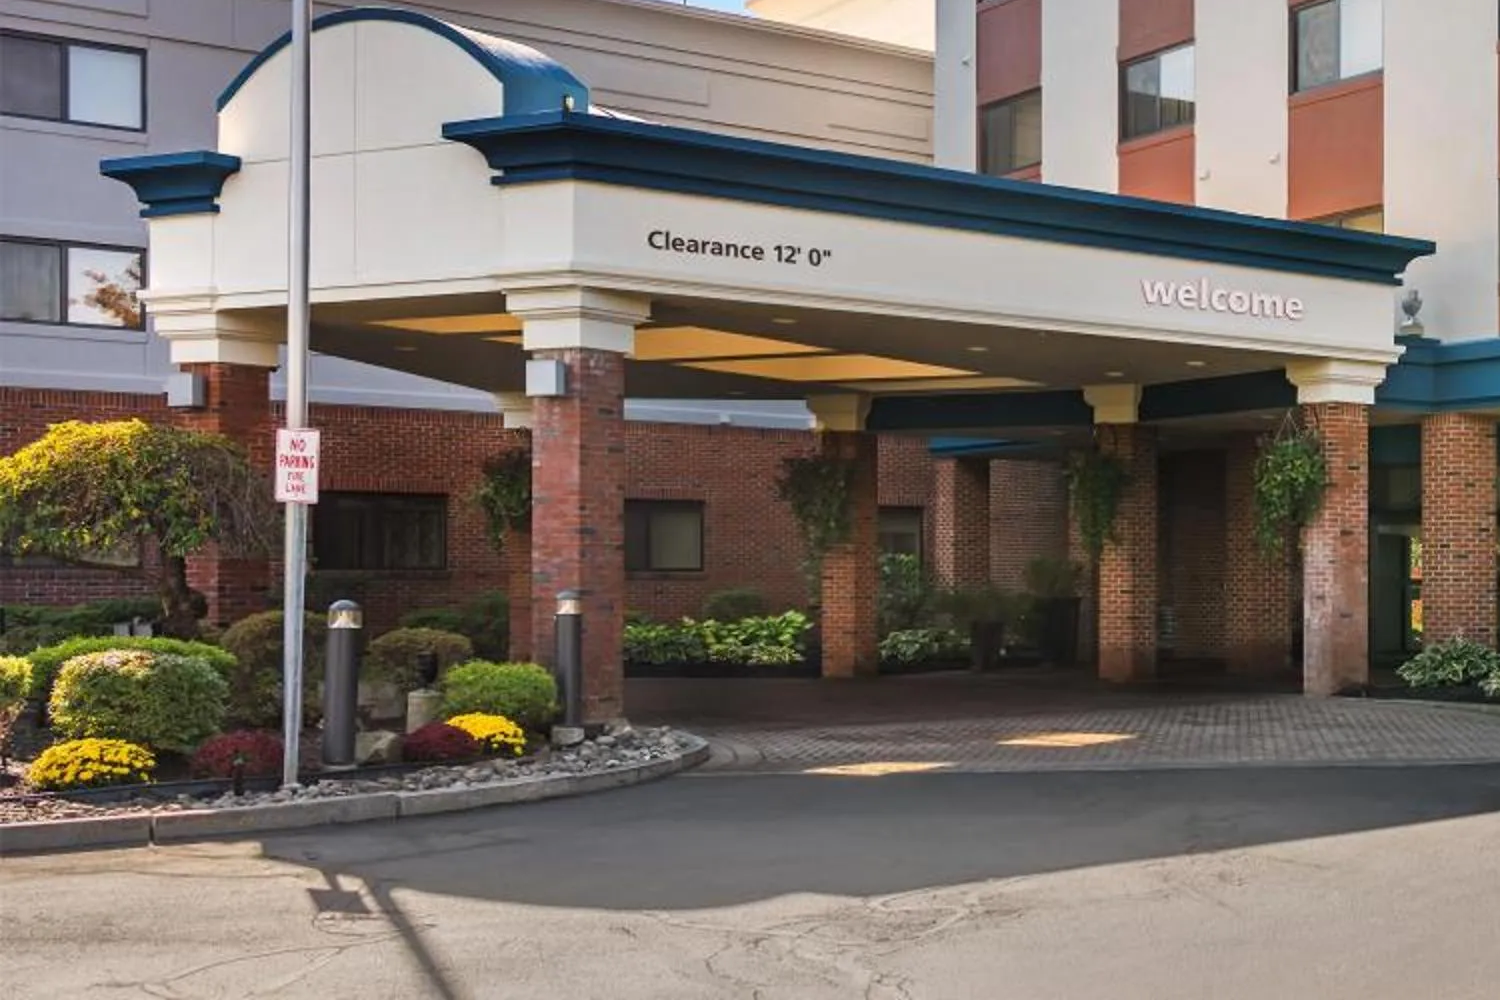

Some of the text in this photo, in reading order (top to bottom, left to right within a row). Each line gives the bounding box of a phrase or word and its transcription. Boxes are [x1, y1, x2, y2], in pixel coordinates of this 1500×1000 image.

[647, 230, 765, 261] Clearance
[773, 244, 802, 265] 12'
[1141, 276, 1304, 321] welcome
[289, 438, 307, 453] NO
[279, 453, 316, 470] PARKING
